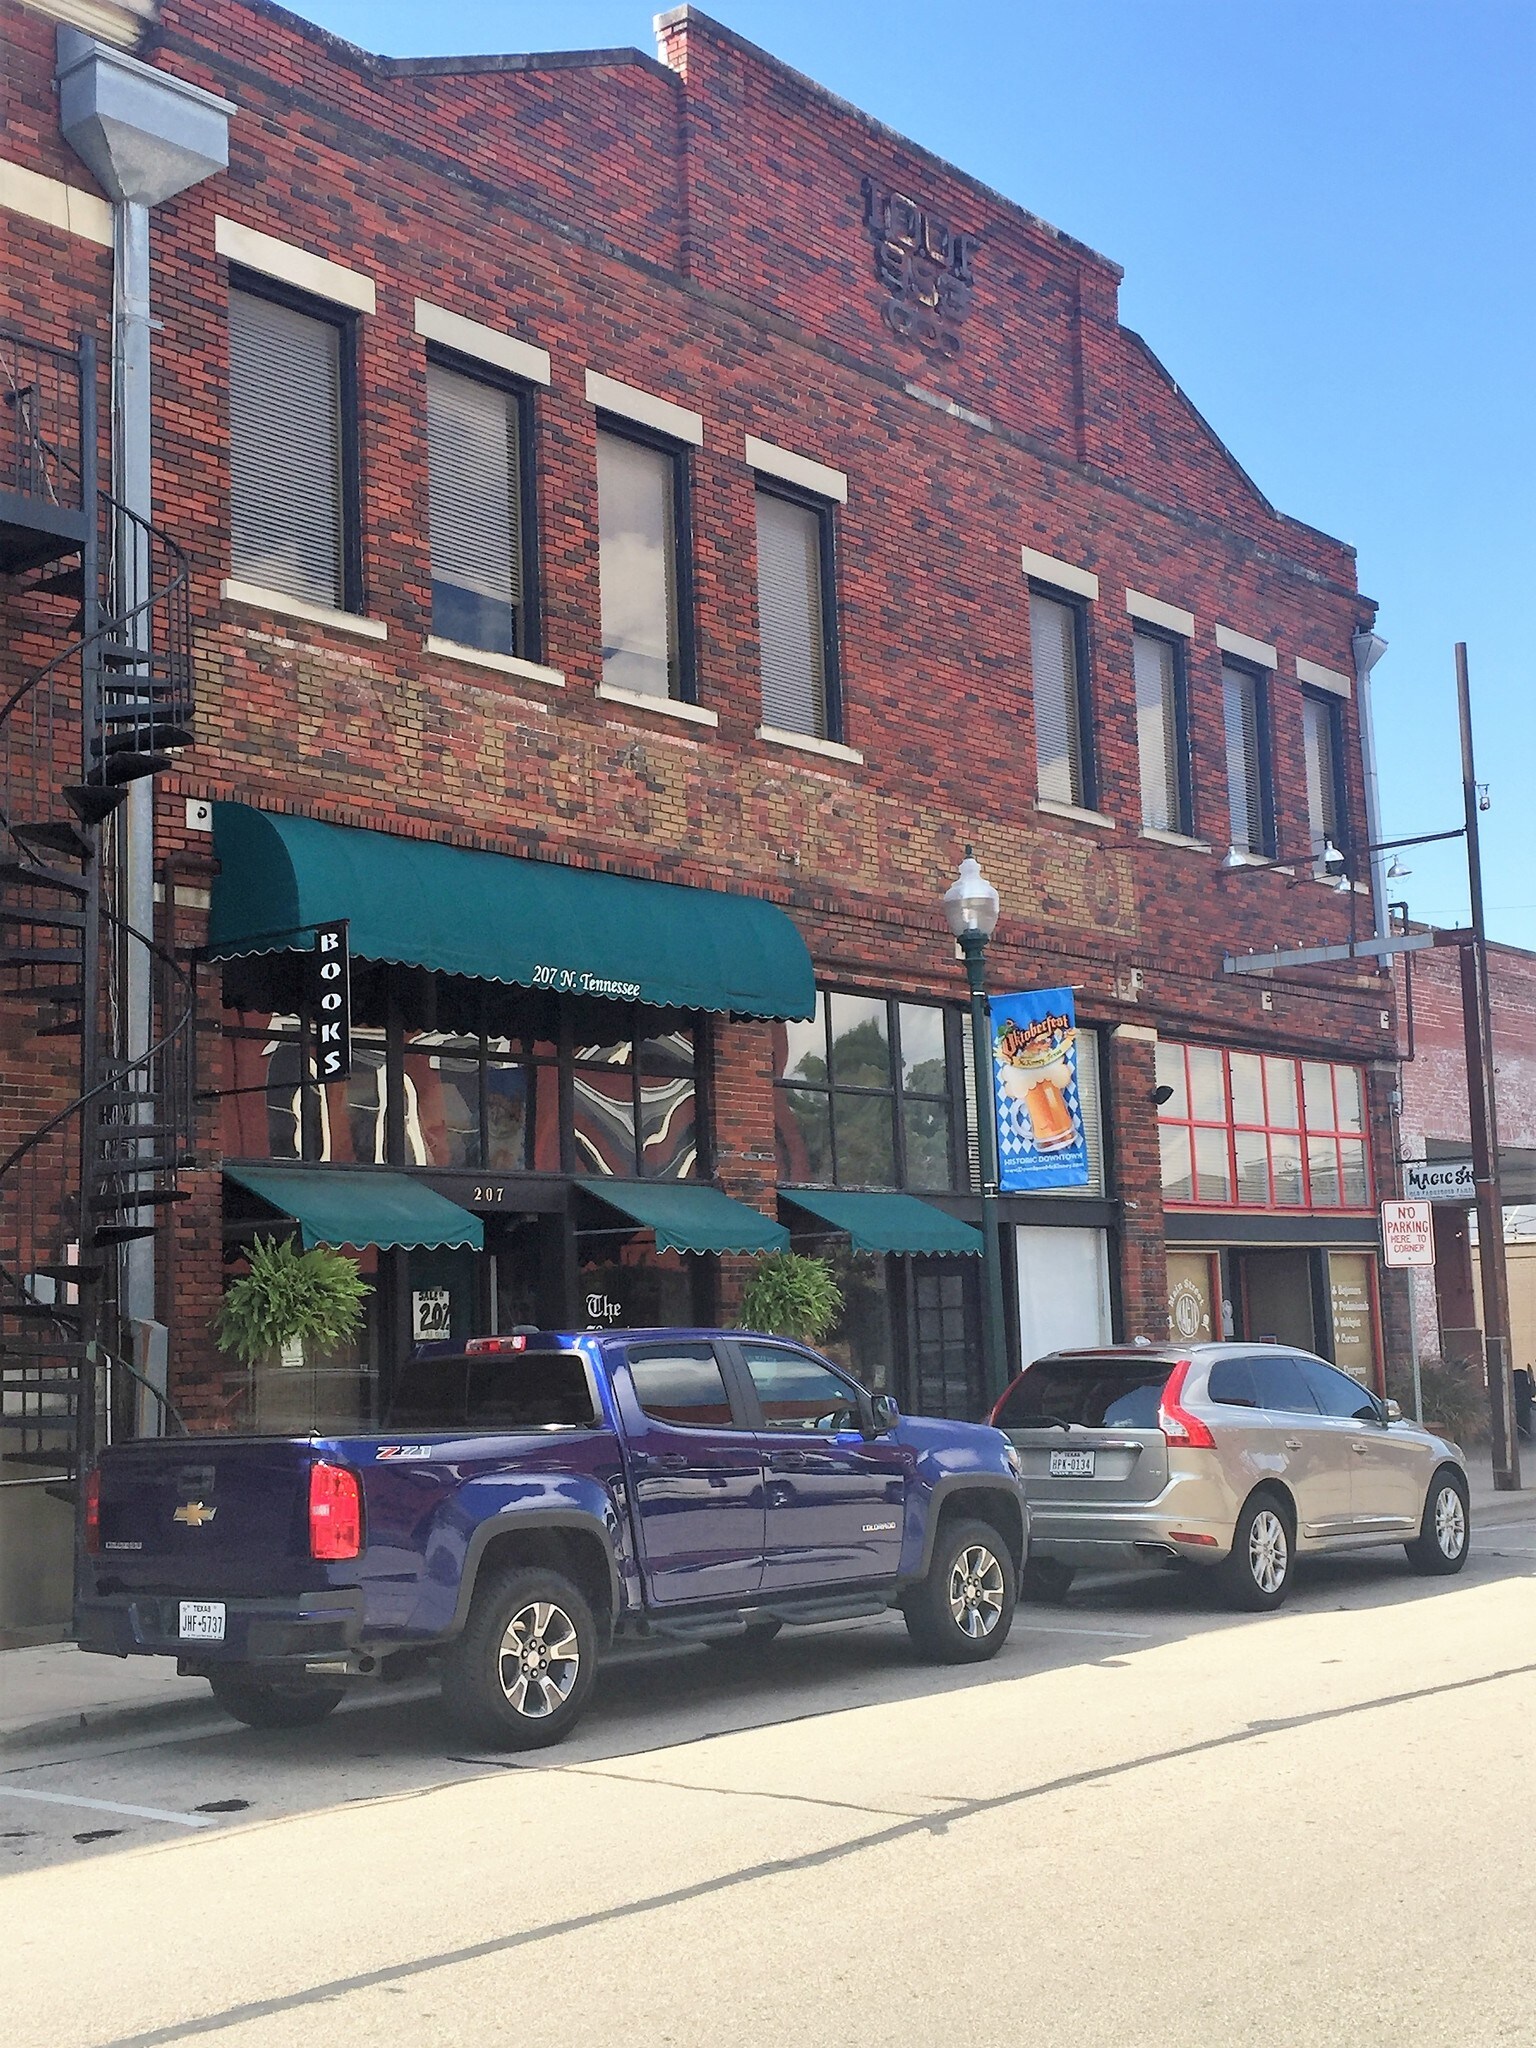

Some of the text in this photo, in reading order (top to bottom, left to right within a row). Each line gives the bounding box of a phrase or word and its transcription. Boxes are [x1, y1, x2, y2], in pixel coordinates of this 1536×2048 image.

[532, 965, 640, 996] 207 N. Tennessee
[320, 933, 342, 1074] BOOKS
[1002, 1015, 1069, 1057] Oktoberfest
[1004, 1152, 1083, 1166] HISTORIC DOWNTOWN
[1408, 1169, 1453, 1190] MAGIC
[473, 1186, 505, 1202] 207
[1397, 1206, 1415, 1219] NO
[1387, 1220, 1429, 1234] PARKING
[1390, 1234, 1427, 1243] HERE TO
[1394, 1244, 1424, 1253] CORNER
[586, 1294, 621, 1323] The
